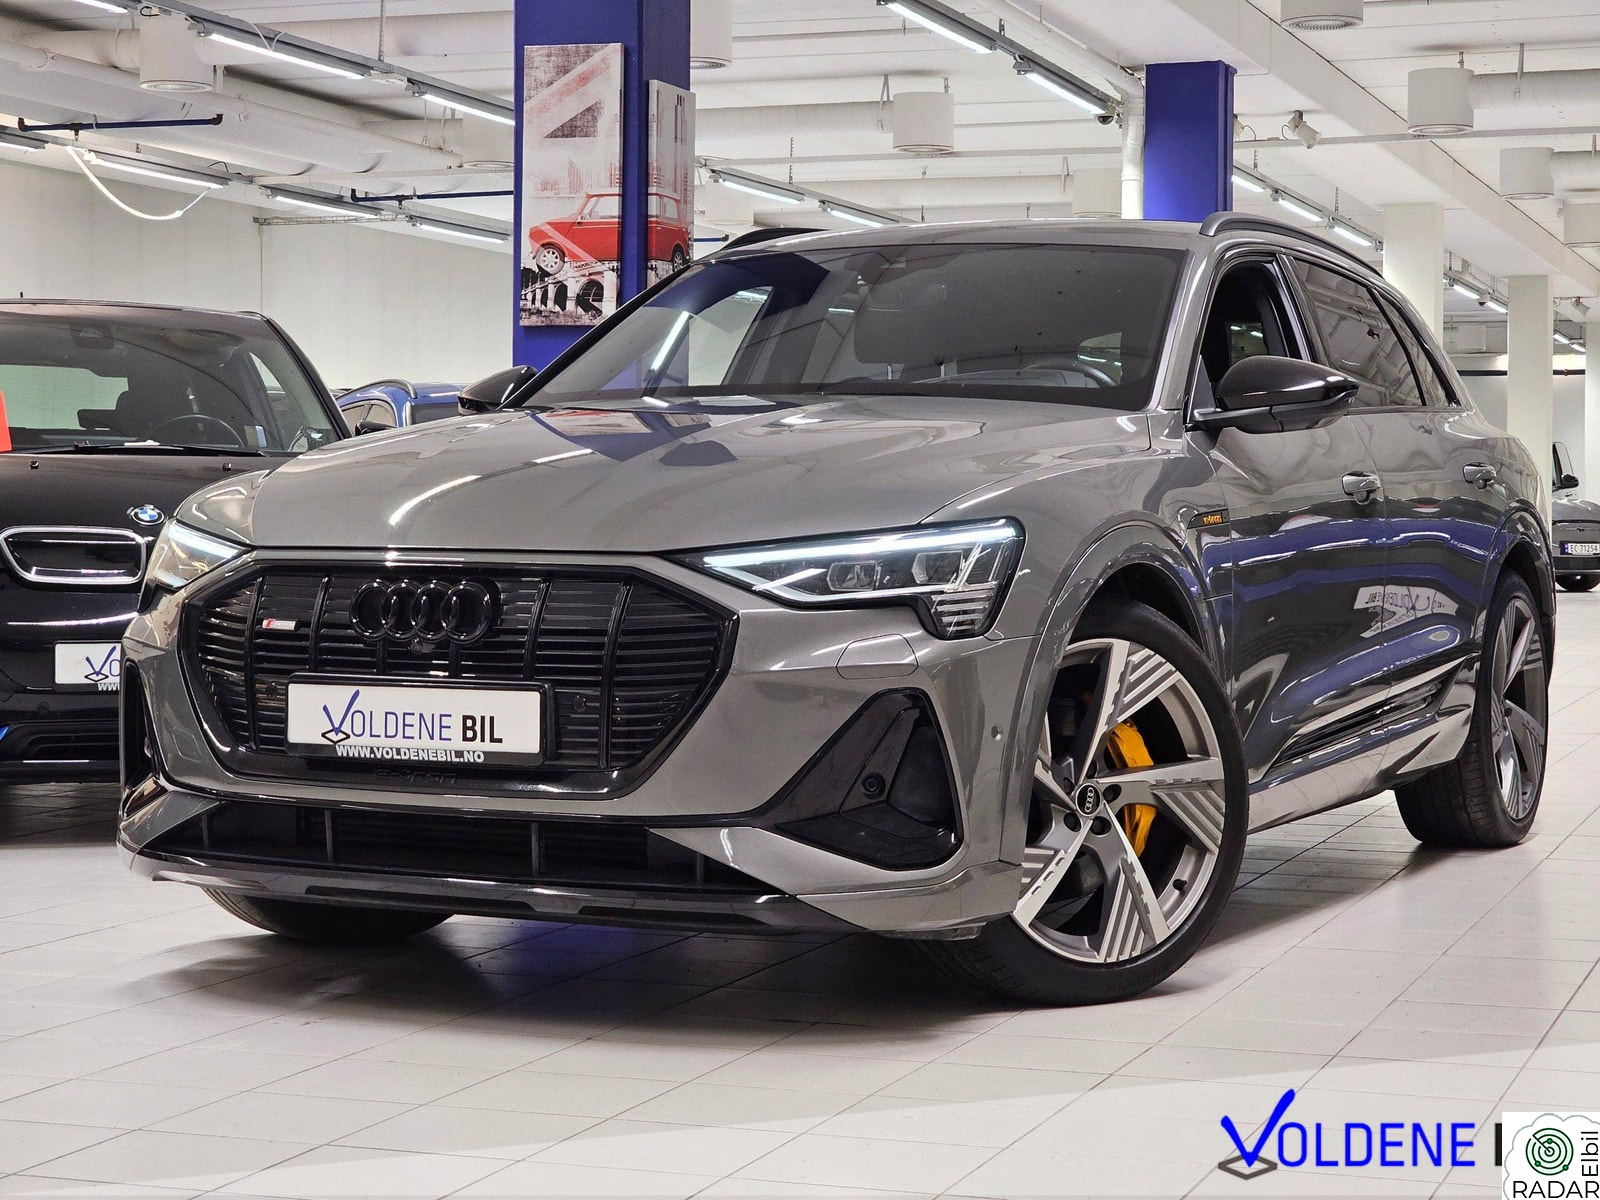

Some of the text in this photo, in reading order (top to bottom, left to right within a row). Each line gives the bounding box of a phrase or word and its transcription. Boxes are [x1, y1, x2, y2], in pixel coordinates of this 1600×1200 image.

[1570, 544, 1598, 553] EC 71254
[322, 689, 503, 743] VOLDENE BIL
[335, 744, 485, 763] WWW.VOLDENEBIL.NO
